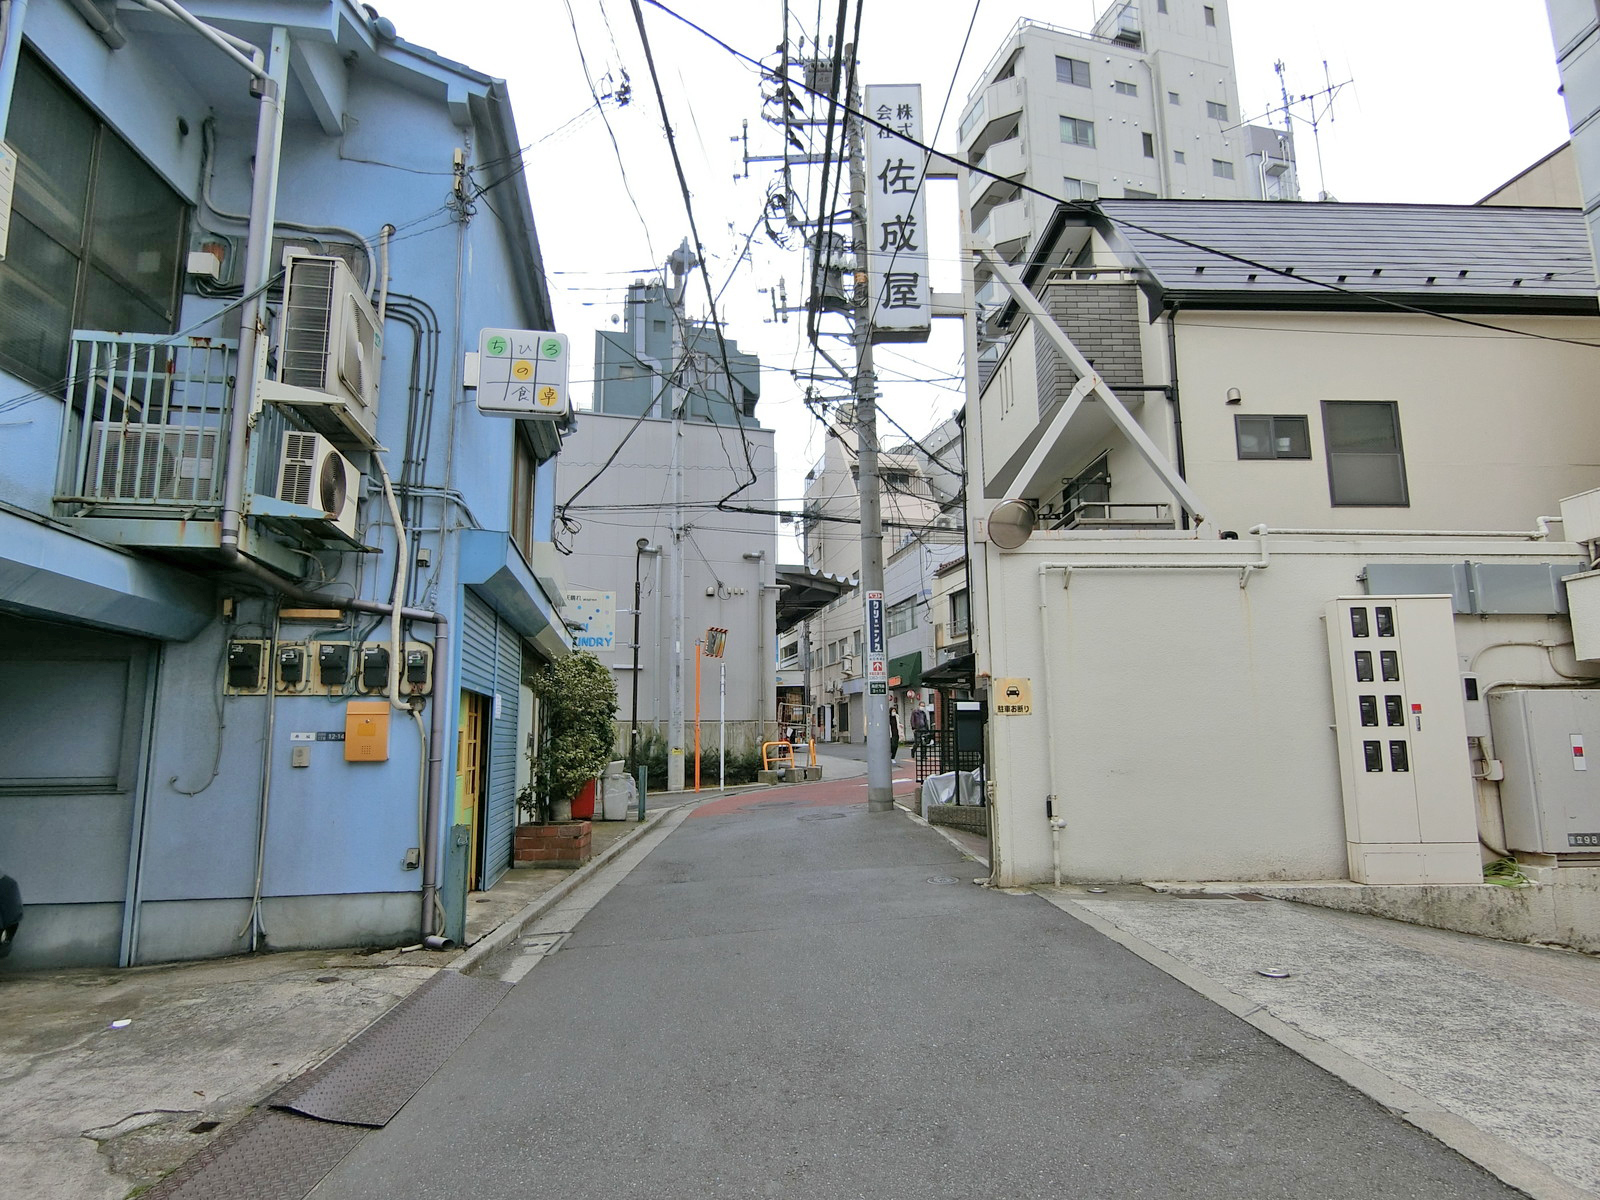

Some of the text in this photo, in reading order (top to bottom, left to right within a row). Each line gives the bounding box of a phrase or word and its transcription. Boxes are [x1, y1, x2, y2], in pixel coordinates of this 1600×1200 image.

[896, 103, 914, 139] 株式
[877, 158, 921, 310] 佐成屋
[491, 340, 558, 356] ちひろ
[516, 367, 529, 376] の
[512, 386, 556, 406] 食卓
[997, 704, 1030, 713] 駐車お断り
